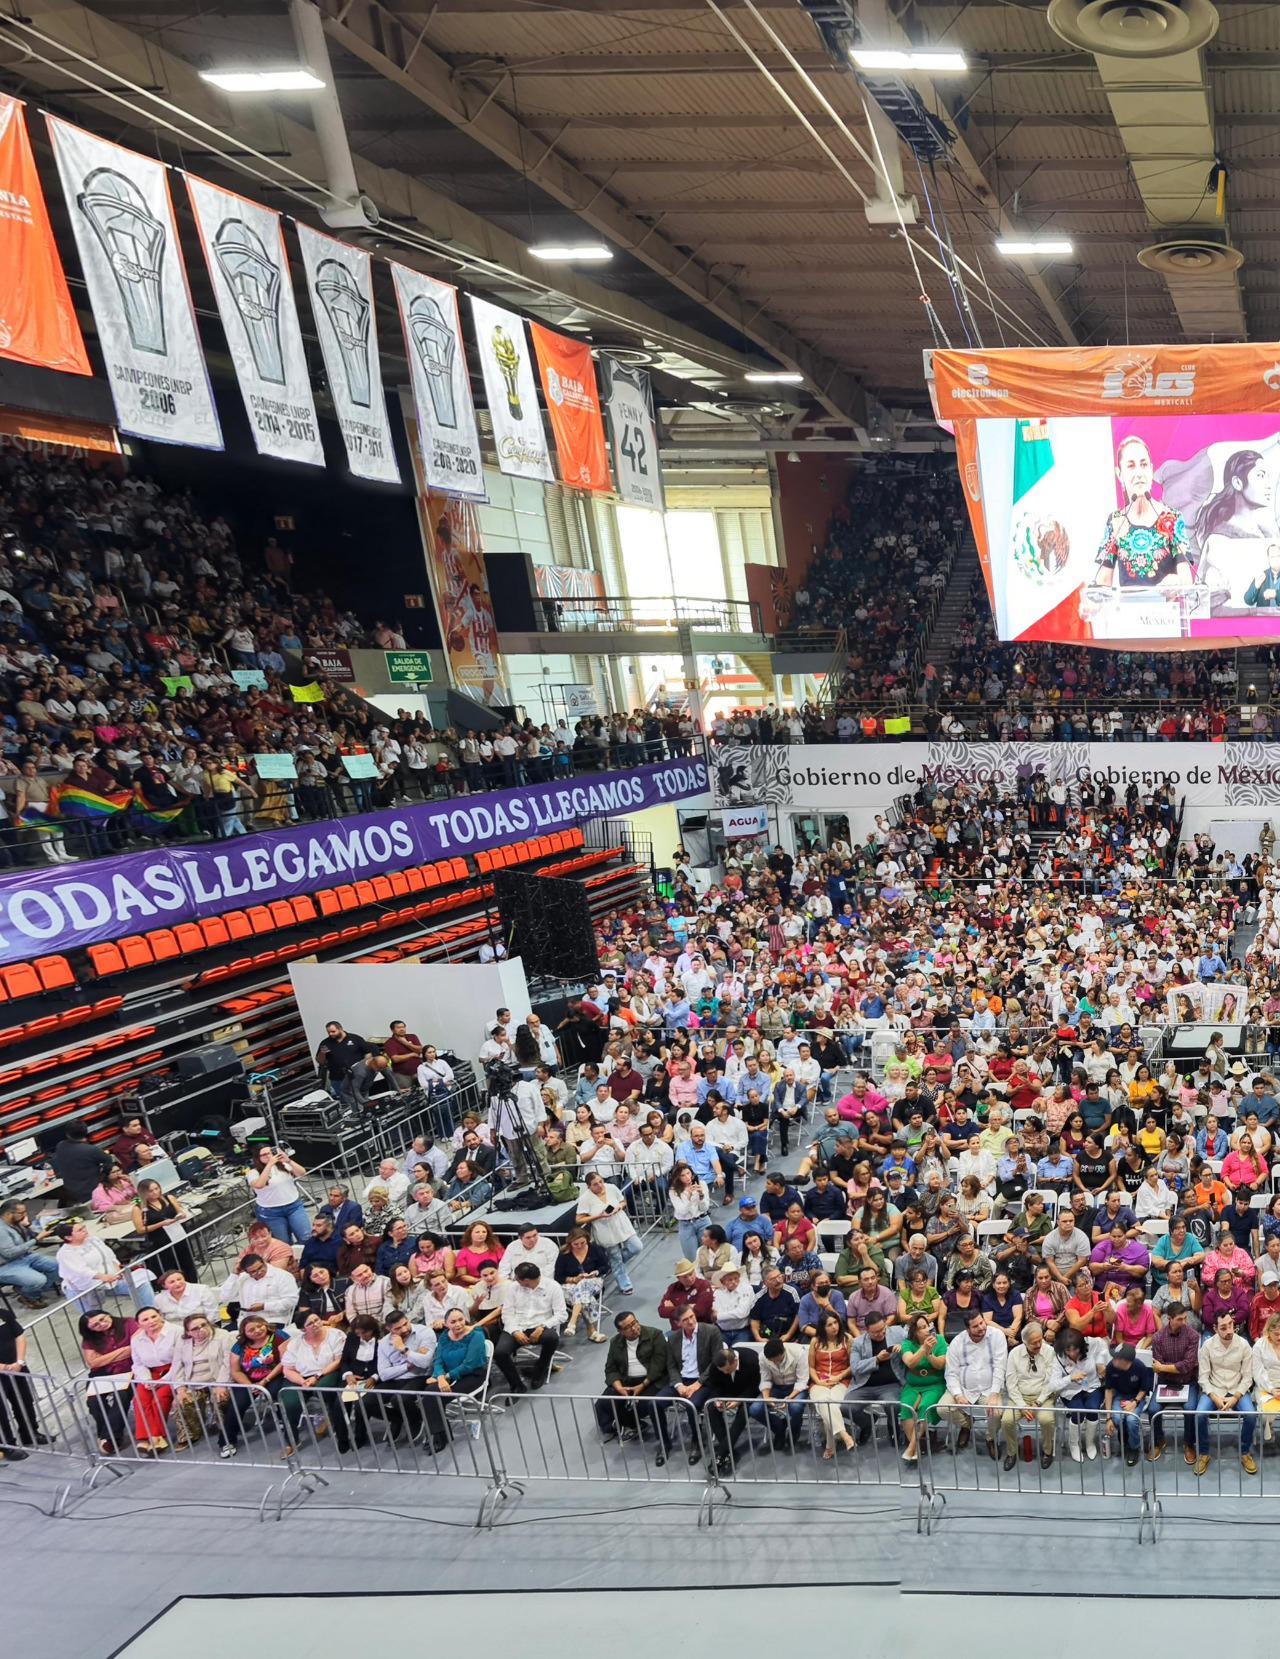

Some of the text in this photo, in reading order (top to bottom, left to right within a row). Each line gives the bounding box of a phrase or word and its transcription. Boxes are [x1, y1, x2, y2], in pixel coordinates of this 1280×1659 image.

[140, 387, 176, 416] 2006
[619, 403, 644, 425] PENNY
[620, 424, 649, 476] 42
[322, 659, 342, 667] BAJA
[776, 763, 1005, 787] Gobierno de México
[1075, 765, 1181, 785] Gobierno
[1186, 765, 1212, 785] de
[728, 816, 758, 828] AGUA
[0, 762, 708, 949] ODAS LLEGAMOS TODAS LLEGAMOS TODAS
